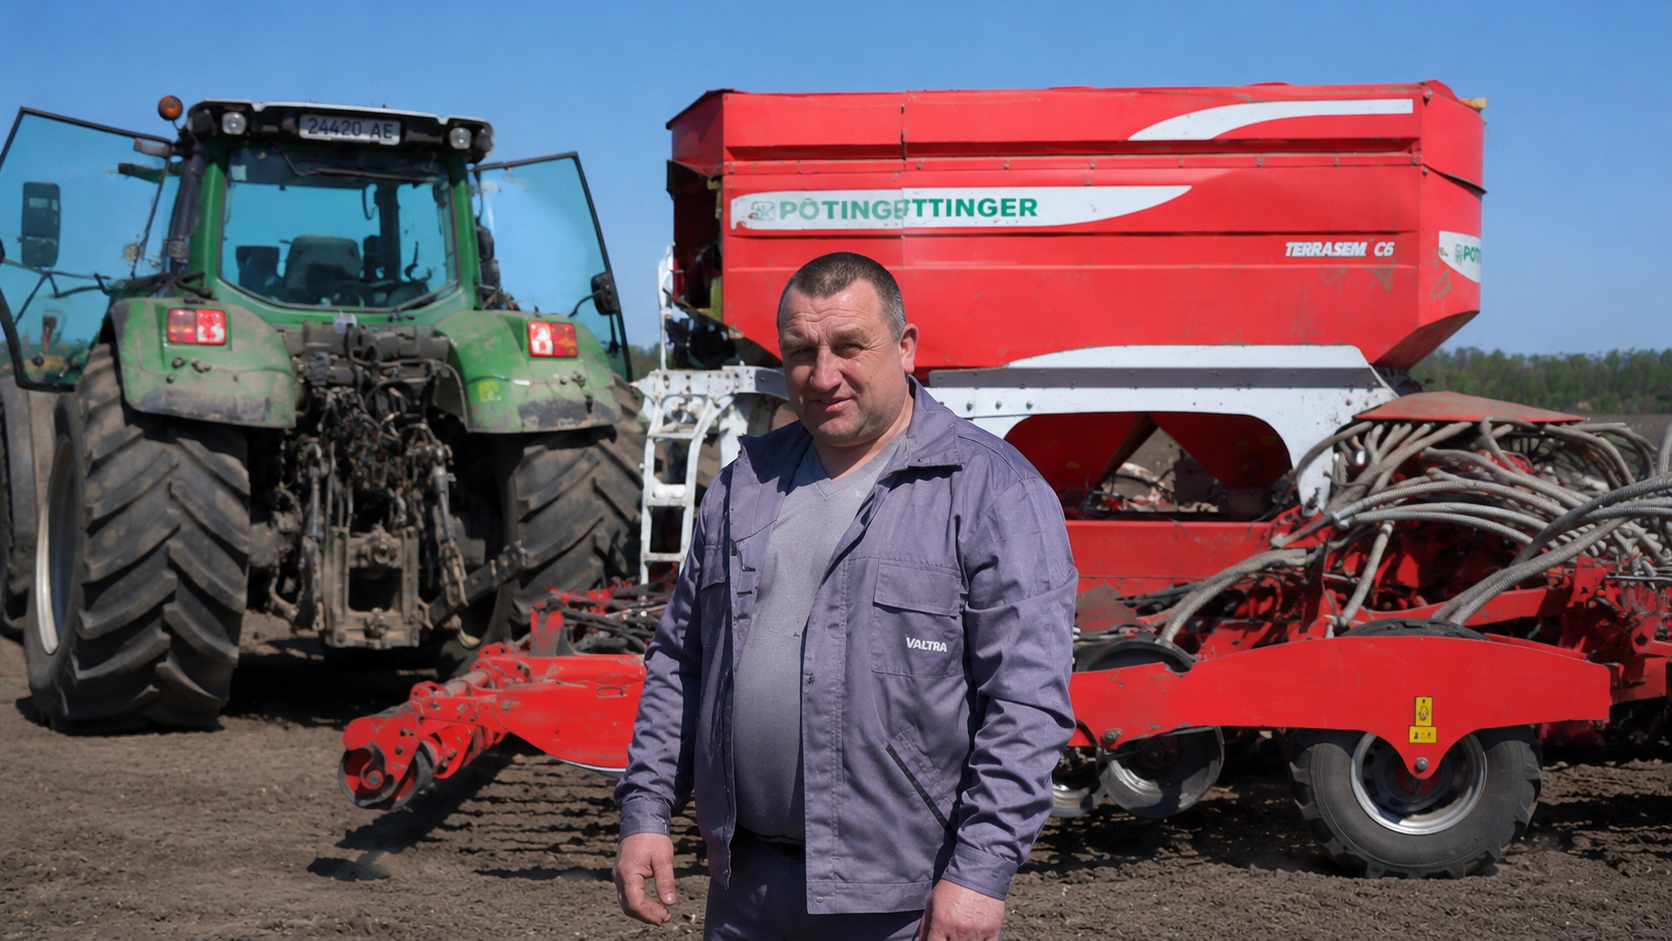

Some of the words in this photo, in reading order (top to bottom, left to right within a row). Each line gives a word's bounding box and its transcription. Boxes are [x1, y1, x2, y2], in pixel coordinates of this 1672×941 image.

[308, 117, 362, 136] 24420
[370, 123, 393, 139] AE
[1285, 241, 1367, 257] TERRASEM
[1373, 241, 1395, 257] C6
[905, 637, 947, 652] VALTRA
